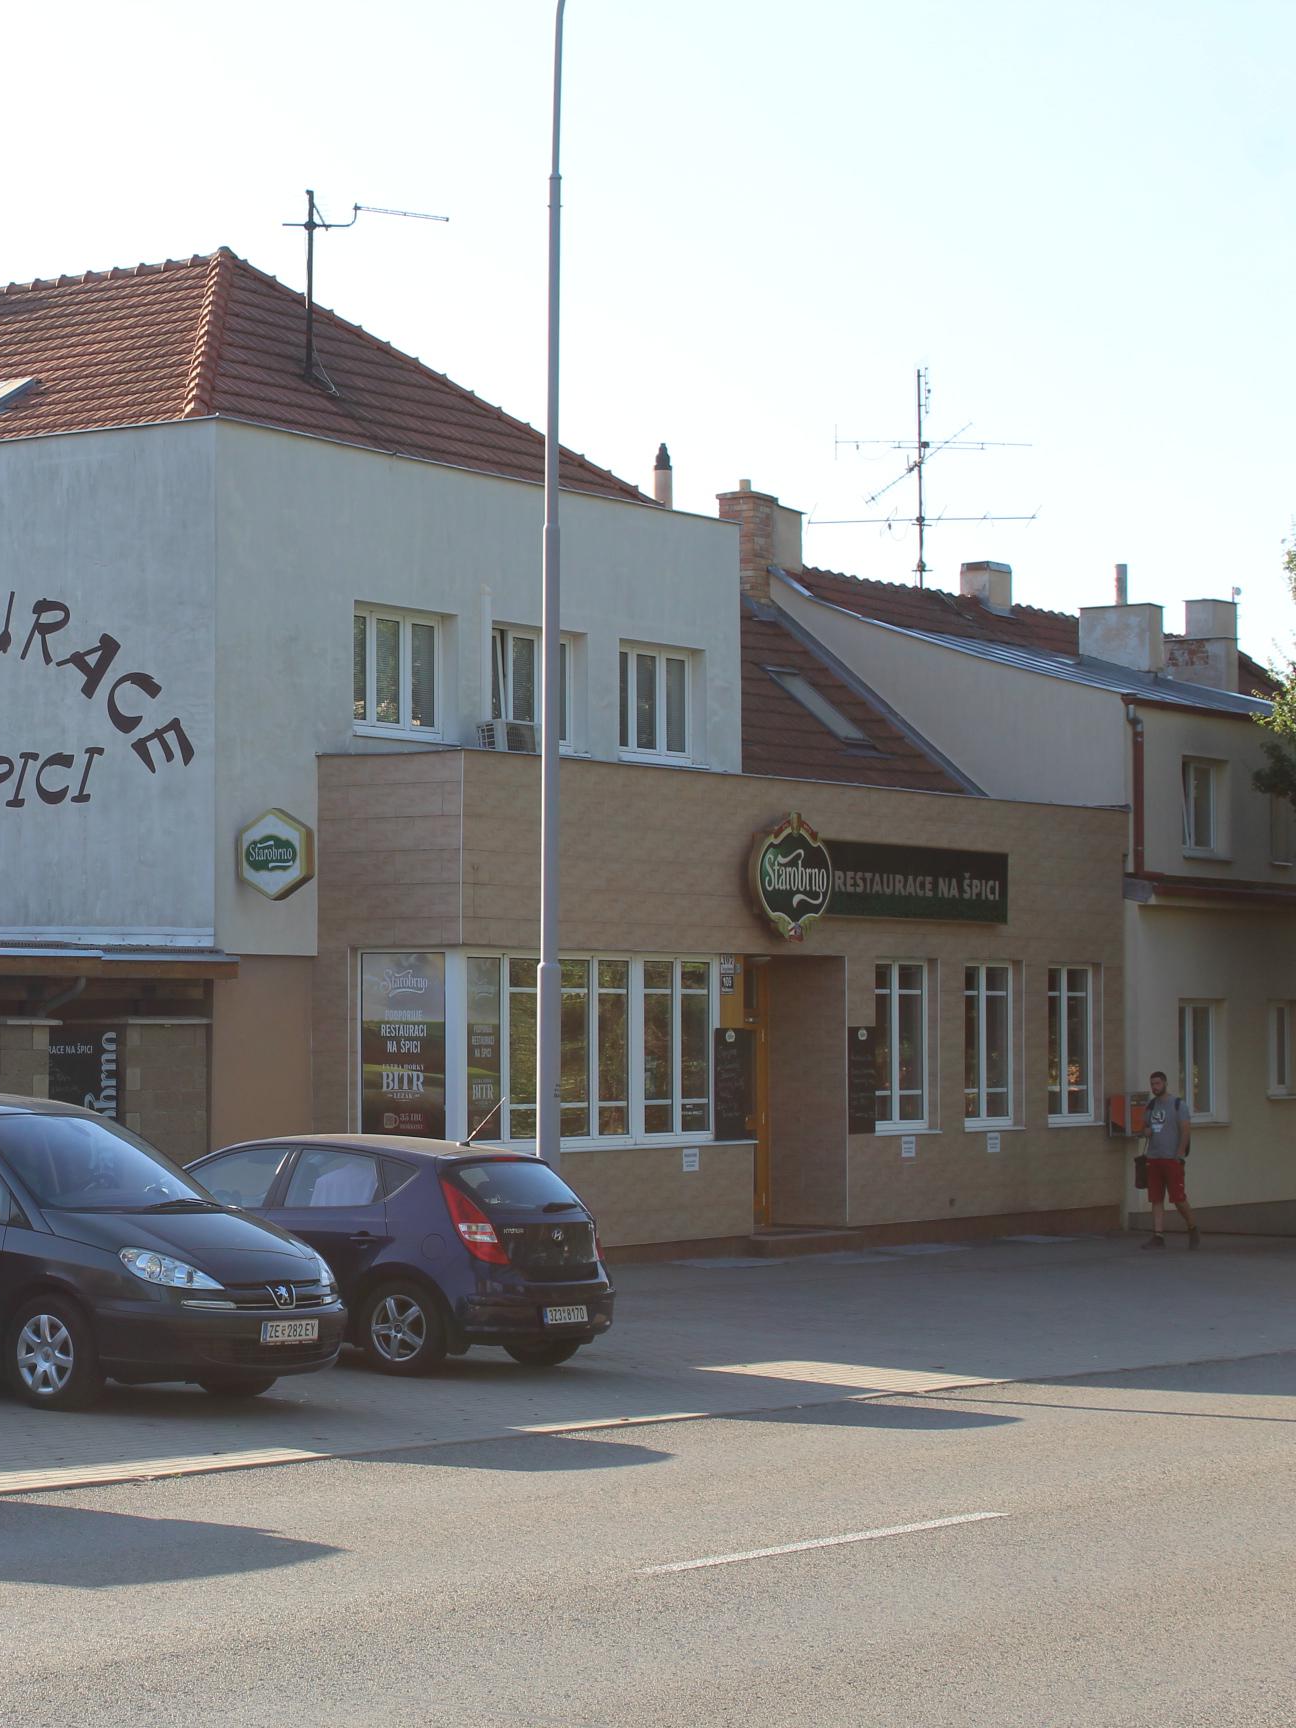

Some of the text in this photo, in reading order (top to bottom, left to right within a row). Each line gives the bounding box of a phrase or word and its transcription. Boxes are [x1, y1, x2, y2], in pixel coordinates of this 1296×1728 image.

[249, 840, 294, 869] Starobrno
[765, 849, 827, 908] Starobrno
[833, 870, 1000, 901] RESTAURACE NA ŠPICI
[380, 968, 429, 998] Starobrno
[381, 1023, 427, 1038] RESTAURACI
[65, 1045, 76, 1054] NA
[76, 1043, 93, 1055] ŠPICI
[387, 1039, 421, 1054] NA ŠPICI
[382, 1071, 424, 1093] BITR
